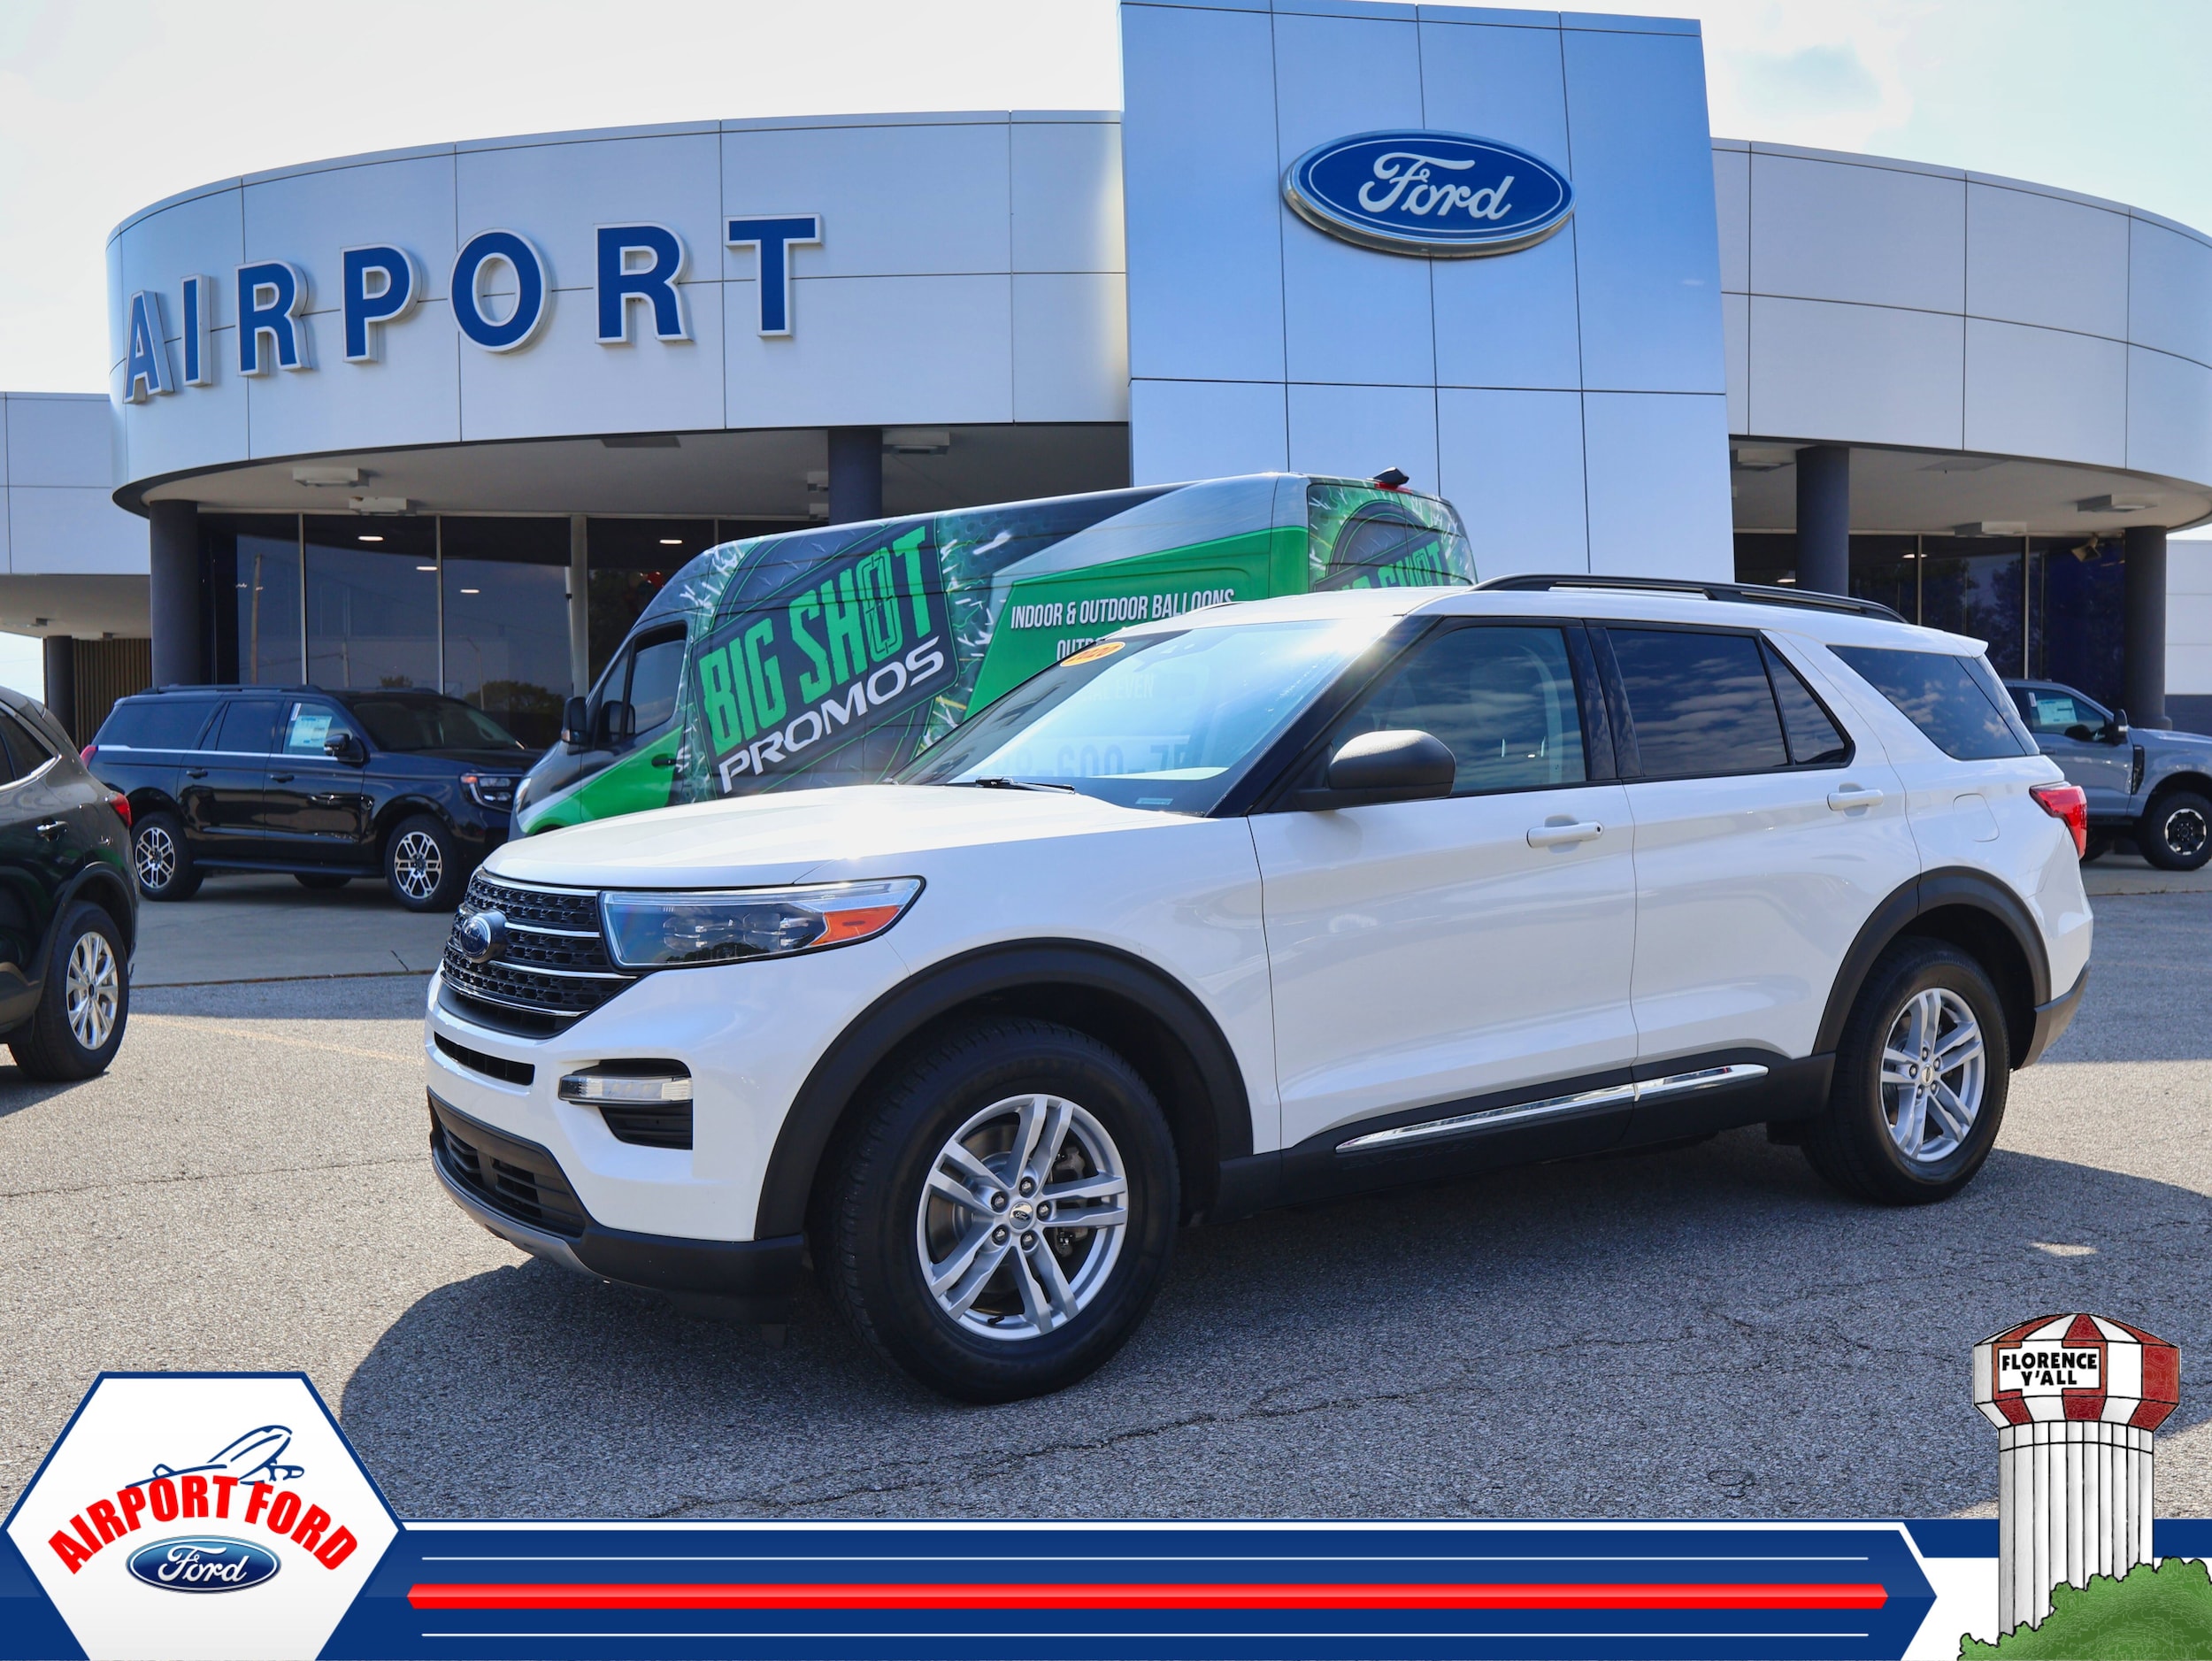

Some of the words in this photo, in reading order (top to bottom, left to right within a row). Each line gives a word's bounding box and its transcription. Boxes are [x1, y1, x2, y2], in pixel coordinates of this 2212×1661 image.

[1358, 152, 1515, 220] Ford
[123, 213, 821, 404] AIRPORT
[699, 618, 787, 757] BIG
[788, 526, 931, 704] SHOT
[1010, 604, 1063, 629] INDOOR
[1066, 602, 1077, 626] &
[1079, 596, 1148, 624] OUTDOOR
[1152, 588, 1234, 619] BALLOONS
[718, 635, 944, 794] PROMOS
